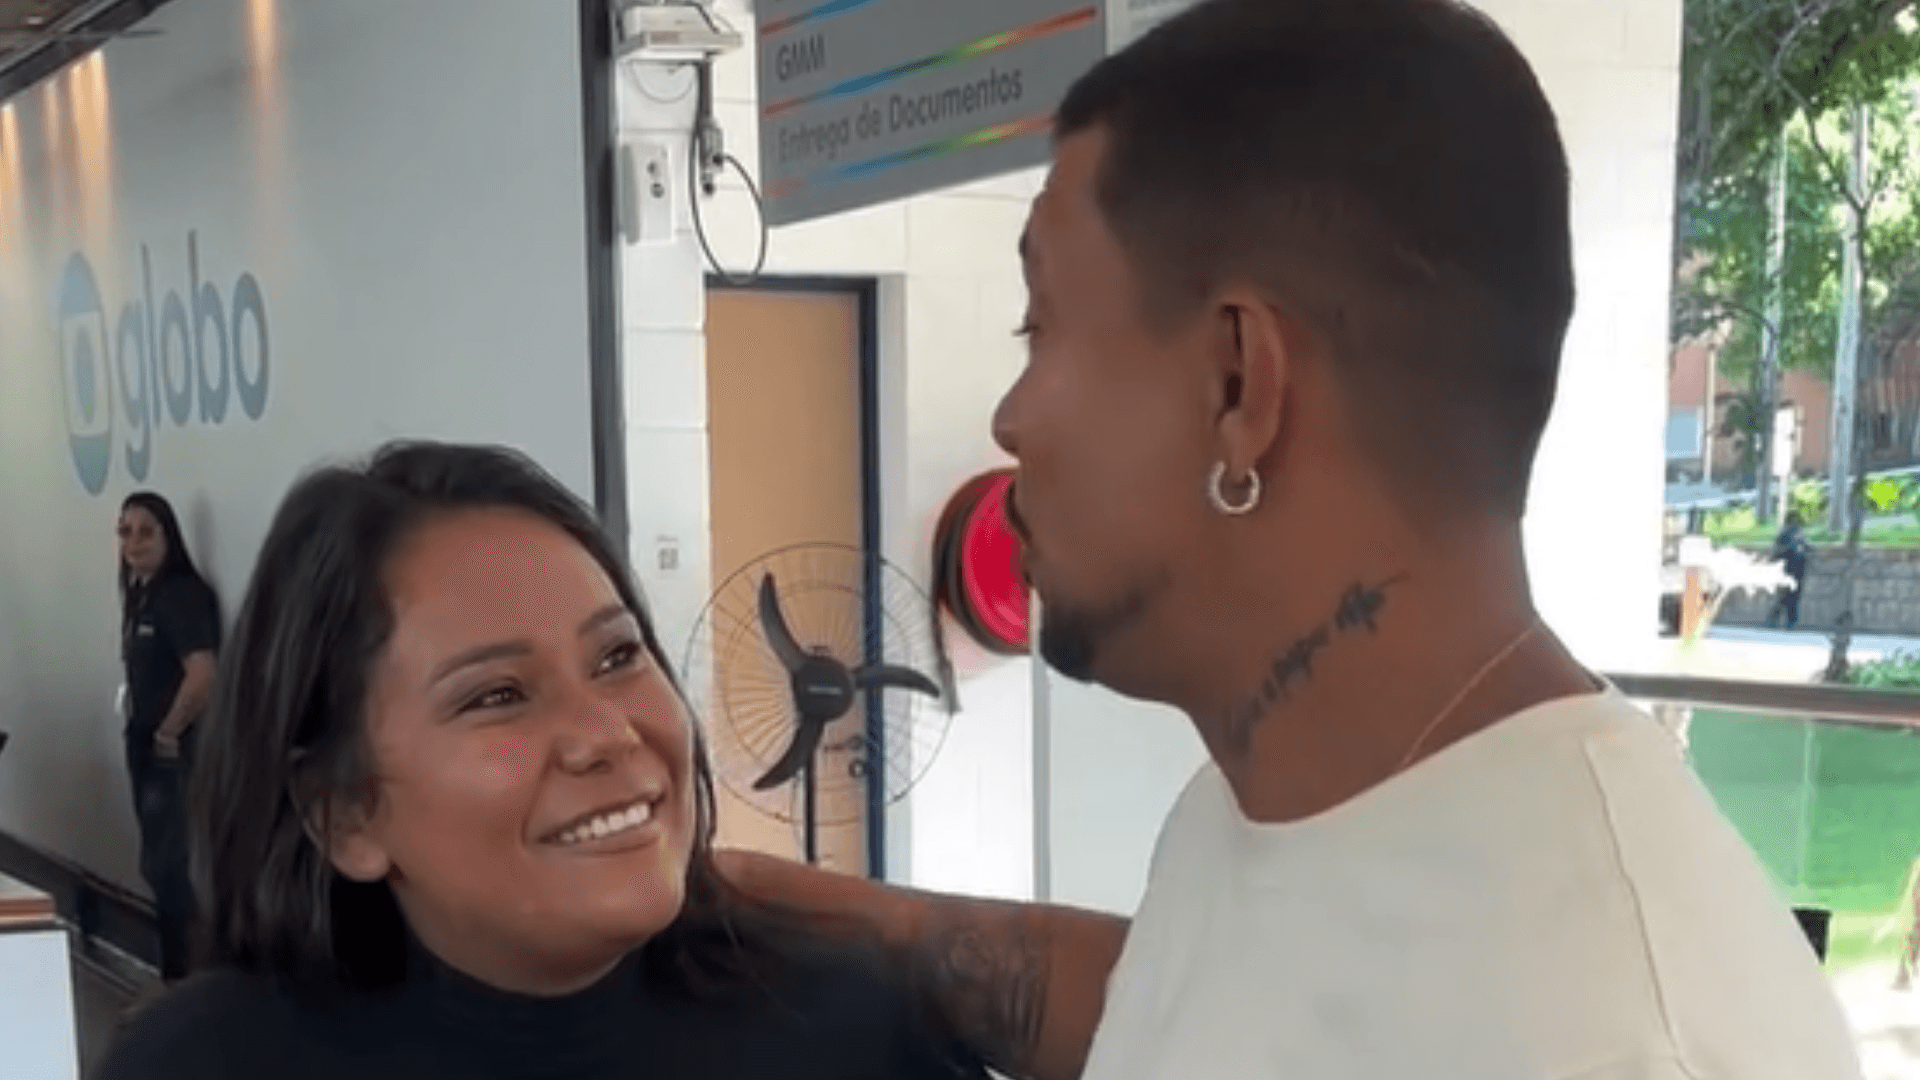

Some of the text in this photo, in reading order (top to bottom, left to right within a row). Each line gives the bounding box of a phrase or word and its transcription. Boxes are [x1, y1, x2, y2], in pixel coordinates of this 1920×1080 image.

[778, 69, 1023, 162] Entrega de Documentos
[118, 229, 269, 483] globo
